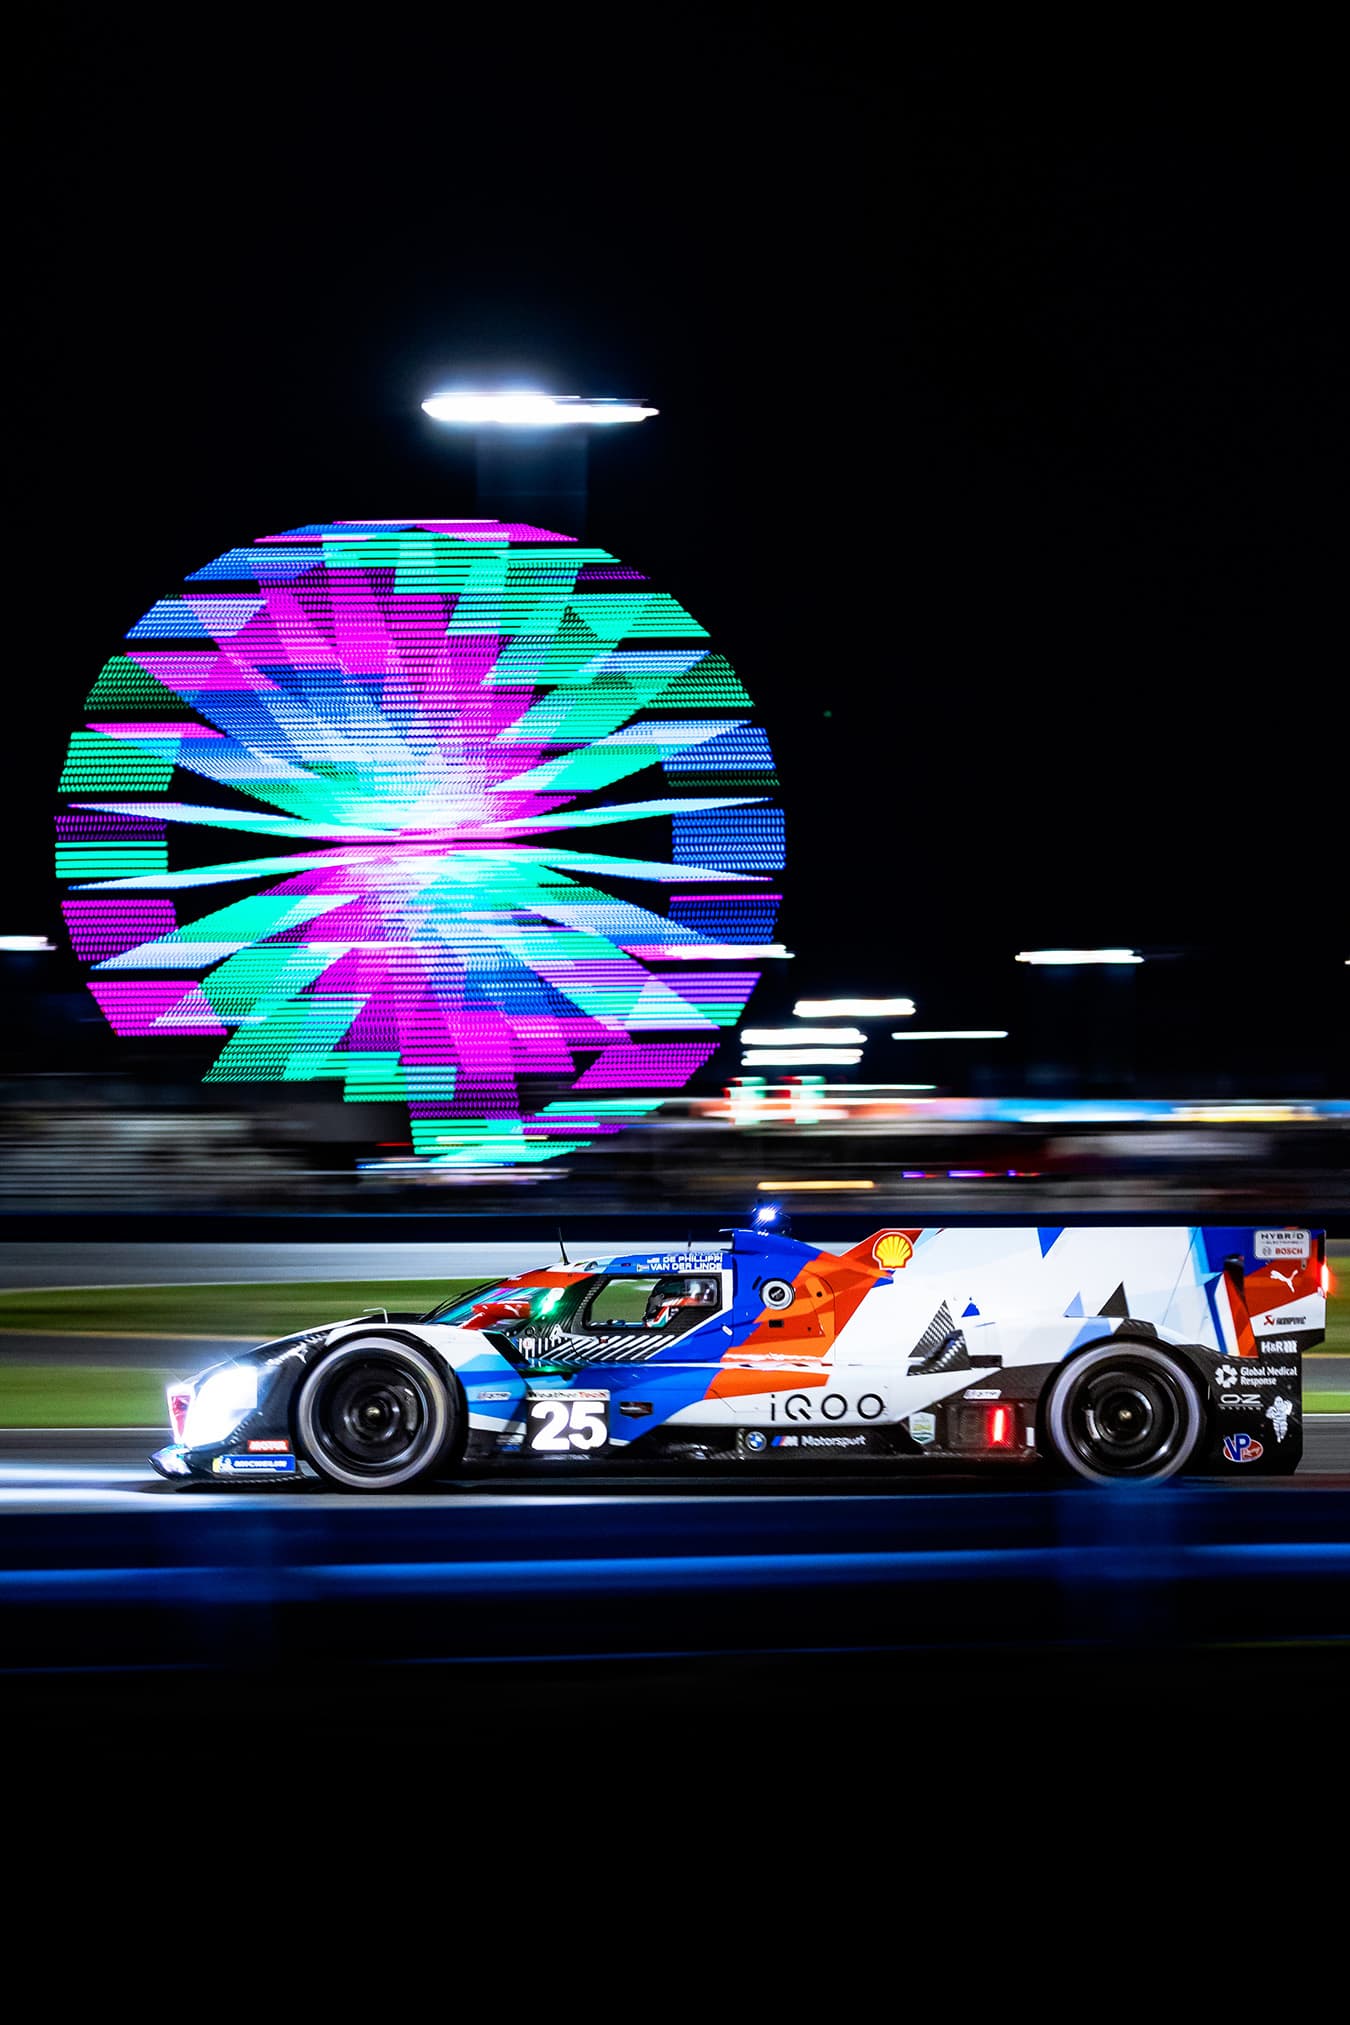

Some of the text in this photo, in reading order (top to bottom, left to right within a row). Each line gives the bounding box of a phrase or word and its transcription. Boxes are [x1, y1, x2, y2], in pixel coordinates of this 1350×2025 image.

[678, 1254, 722, 1262] PHILLIPPI
[650, 1262, 722, 1271] VAN DER LINDE
[1261, 1341, 1283, 1353] H&R
[1240, 1366, 1298, 1376] Global Medical
[1240, 1377, 1277, 1387] Response
[1220, 1394, 1261, 1404] OZ
[770, 1394, 884, 1421] iQOO
[531, 1401, 607, 1450] 25
[801, 1434, 867, 1448] Motorsport
[1223, 1433, 1251, 1462] VP
